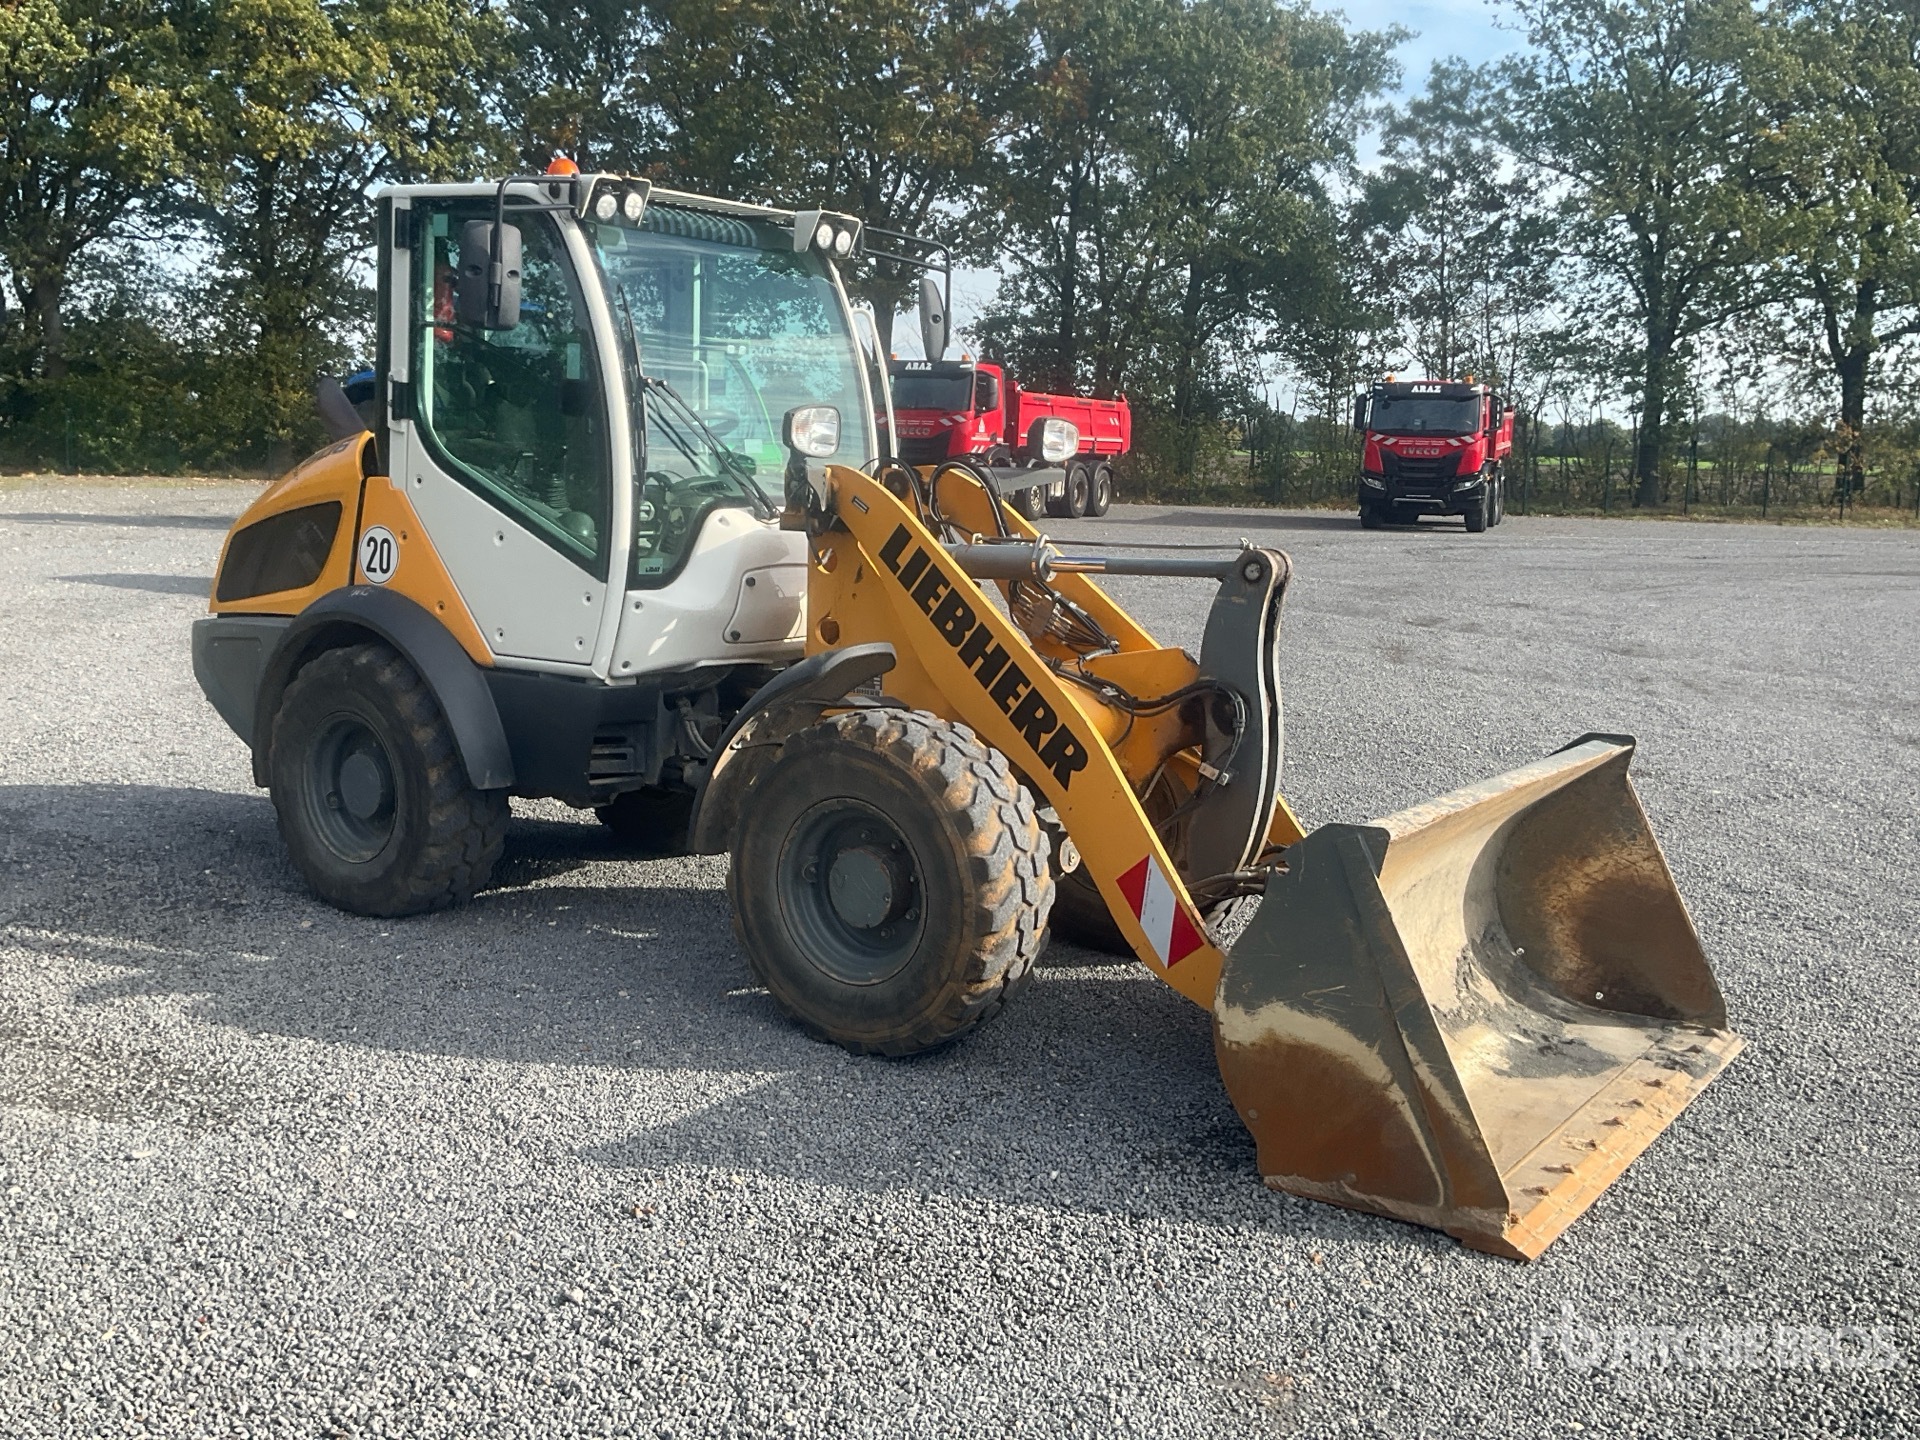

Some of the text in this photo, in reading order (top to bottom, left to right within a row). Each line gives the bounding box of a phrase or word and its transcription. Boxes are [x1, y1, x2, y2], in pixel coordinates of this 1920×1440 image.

[905, 362, 932, 371] ARAZ
[1411, 385, 1442, 393] ARAZ
[1403, 447, 1440, 456] IVECO
[366, 536, 391, 574] 20
[878, 523, 1088, 792] LIEBHERR
